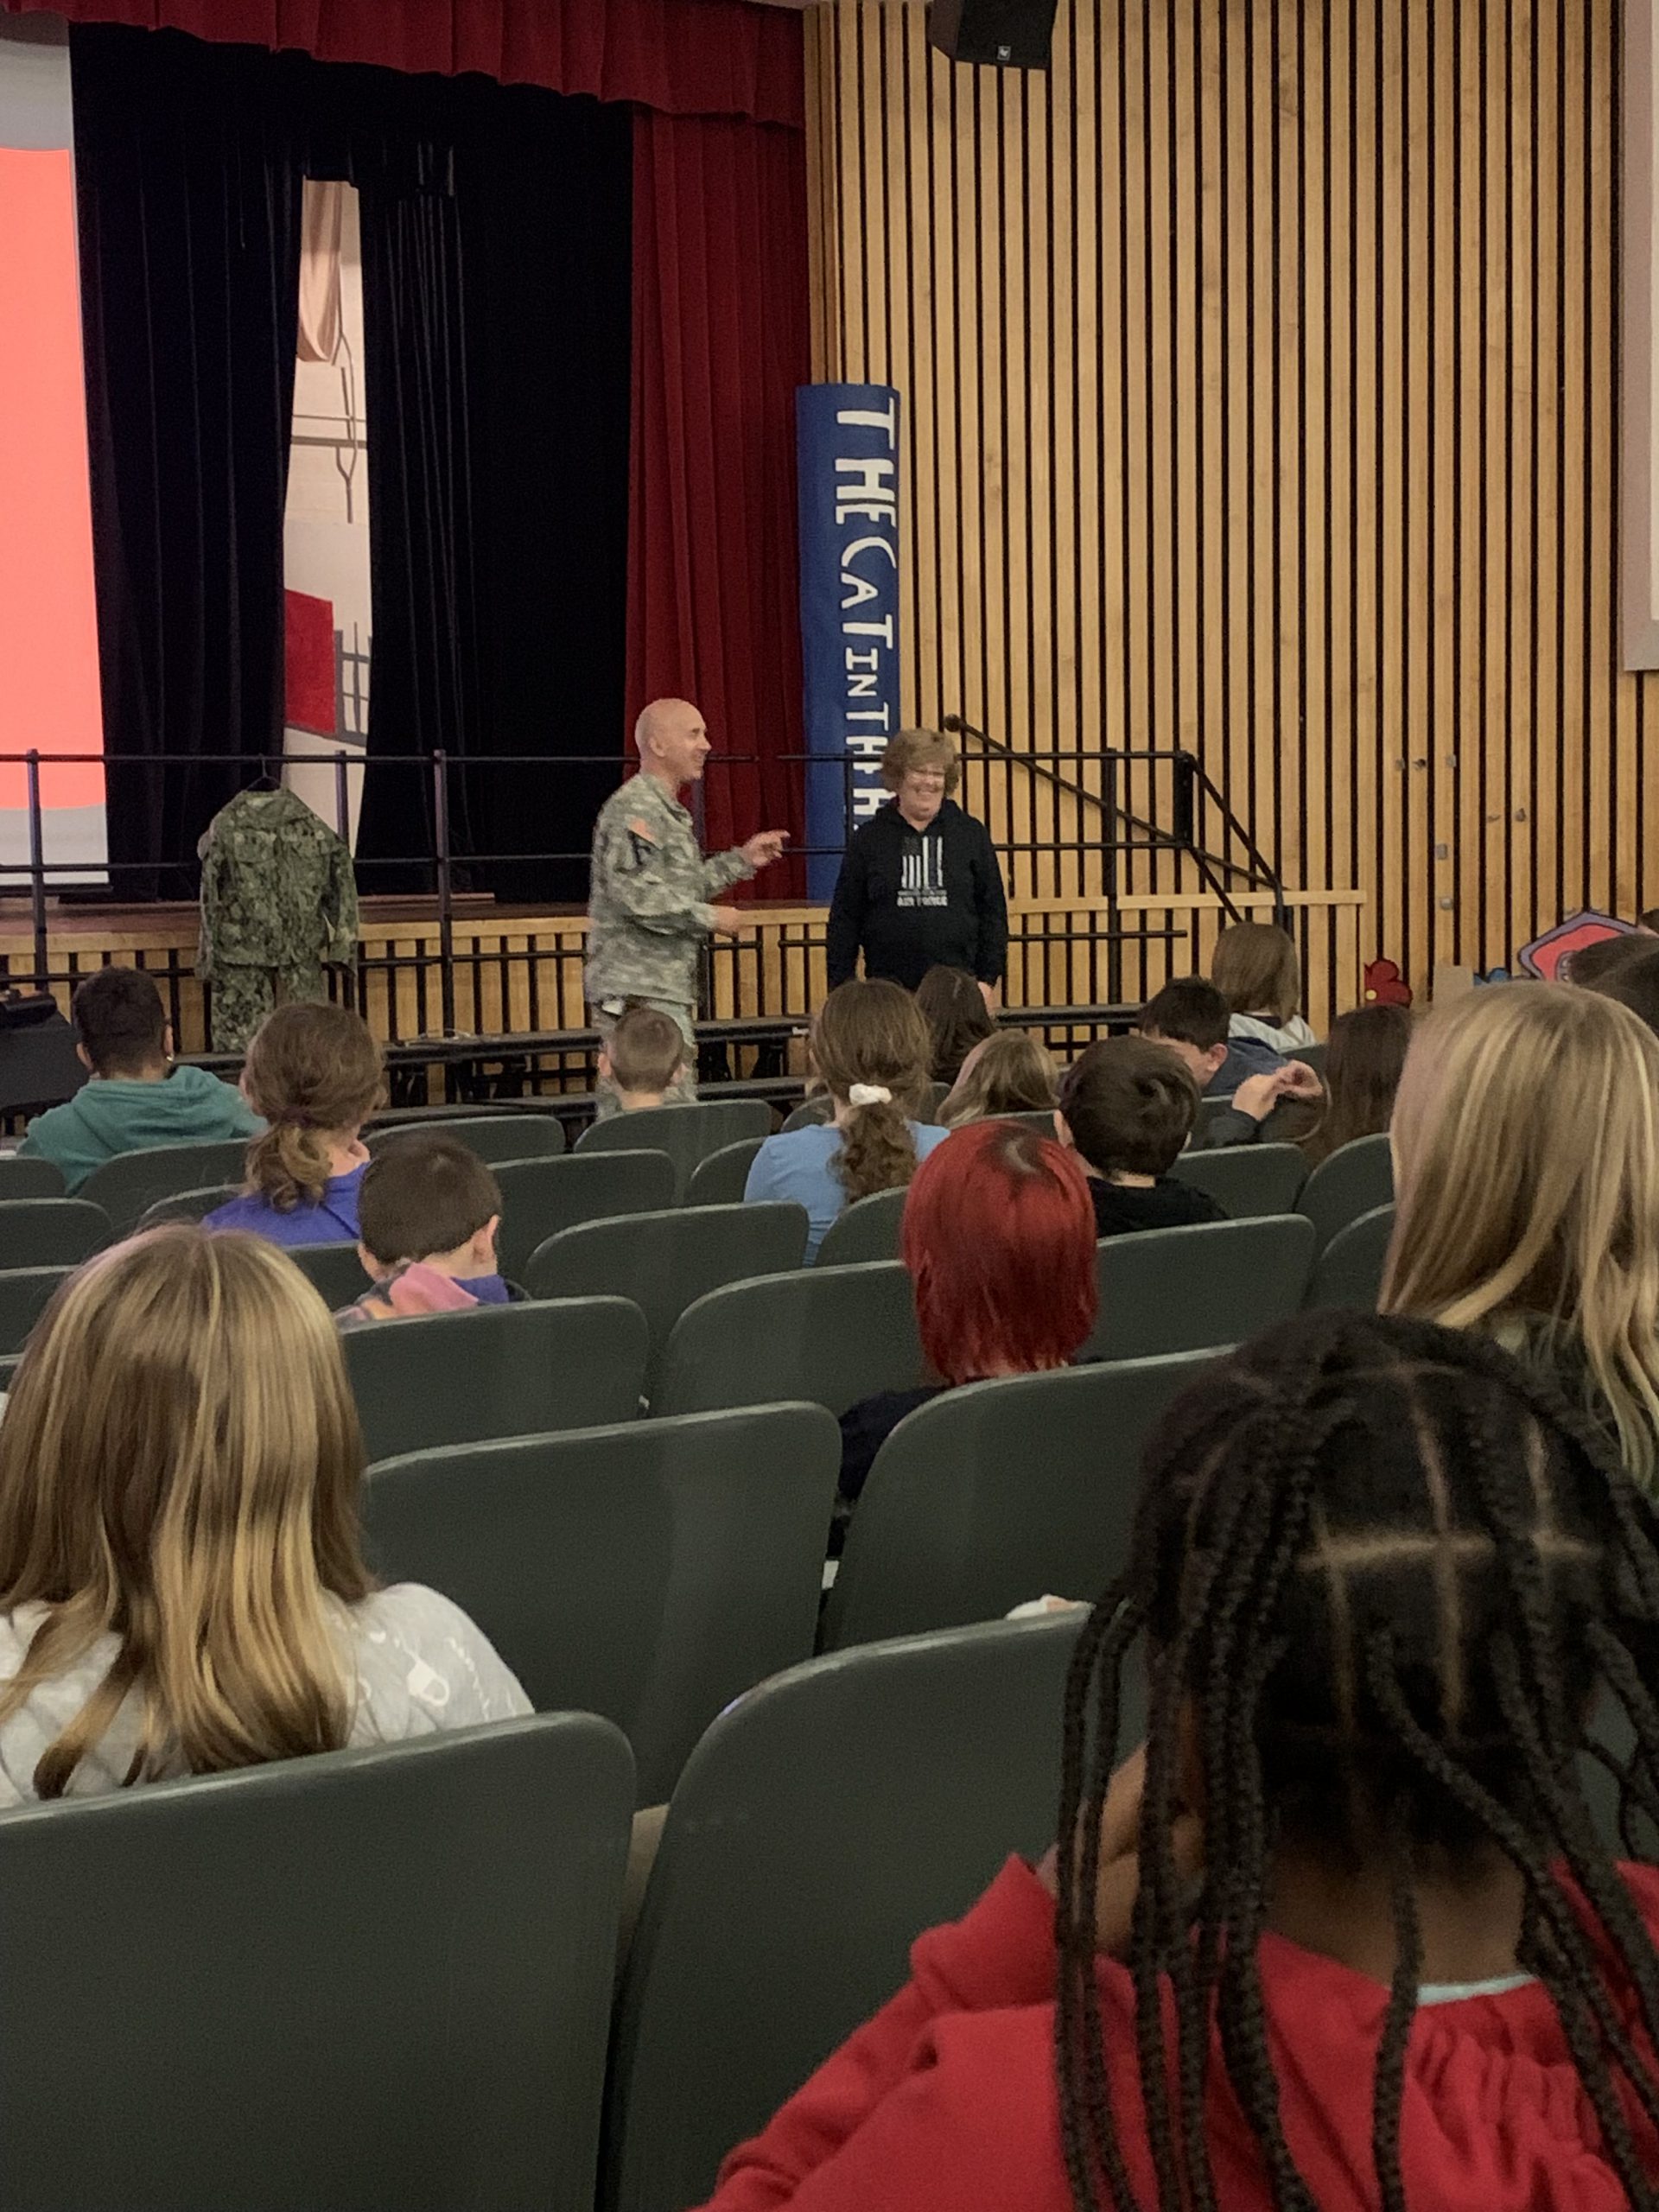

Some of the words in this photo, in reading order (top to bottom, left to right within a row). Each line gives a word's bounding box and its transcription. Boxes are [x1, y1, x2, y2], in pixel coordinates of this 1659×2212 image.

[835, 397, 896, 528] THE
[841, 537, 897, 649] CAT
[845, 647, 879, 697] IN
